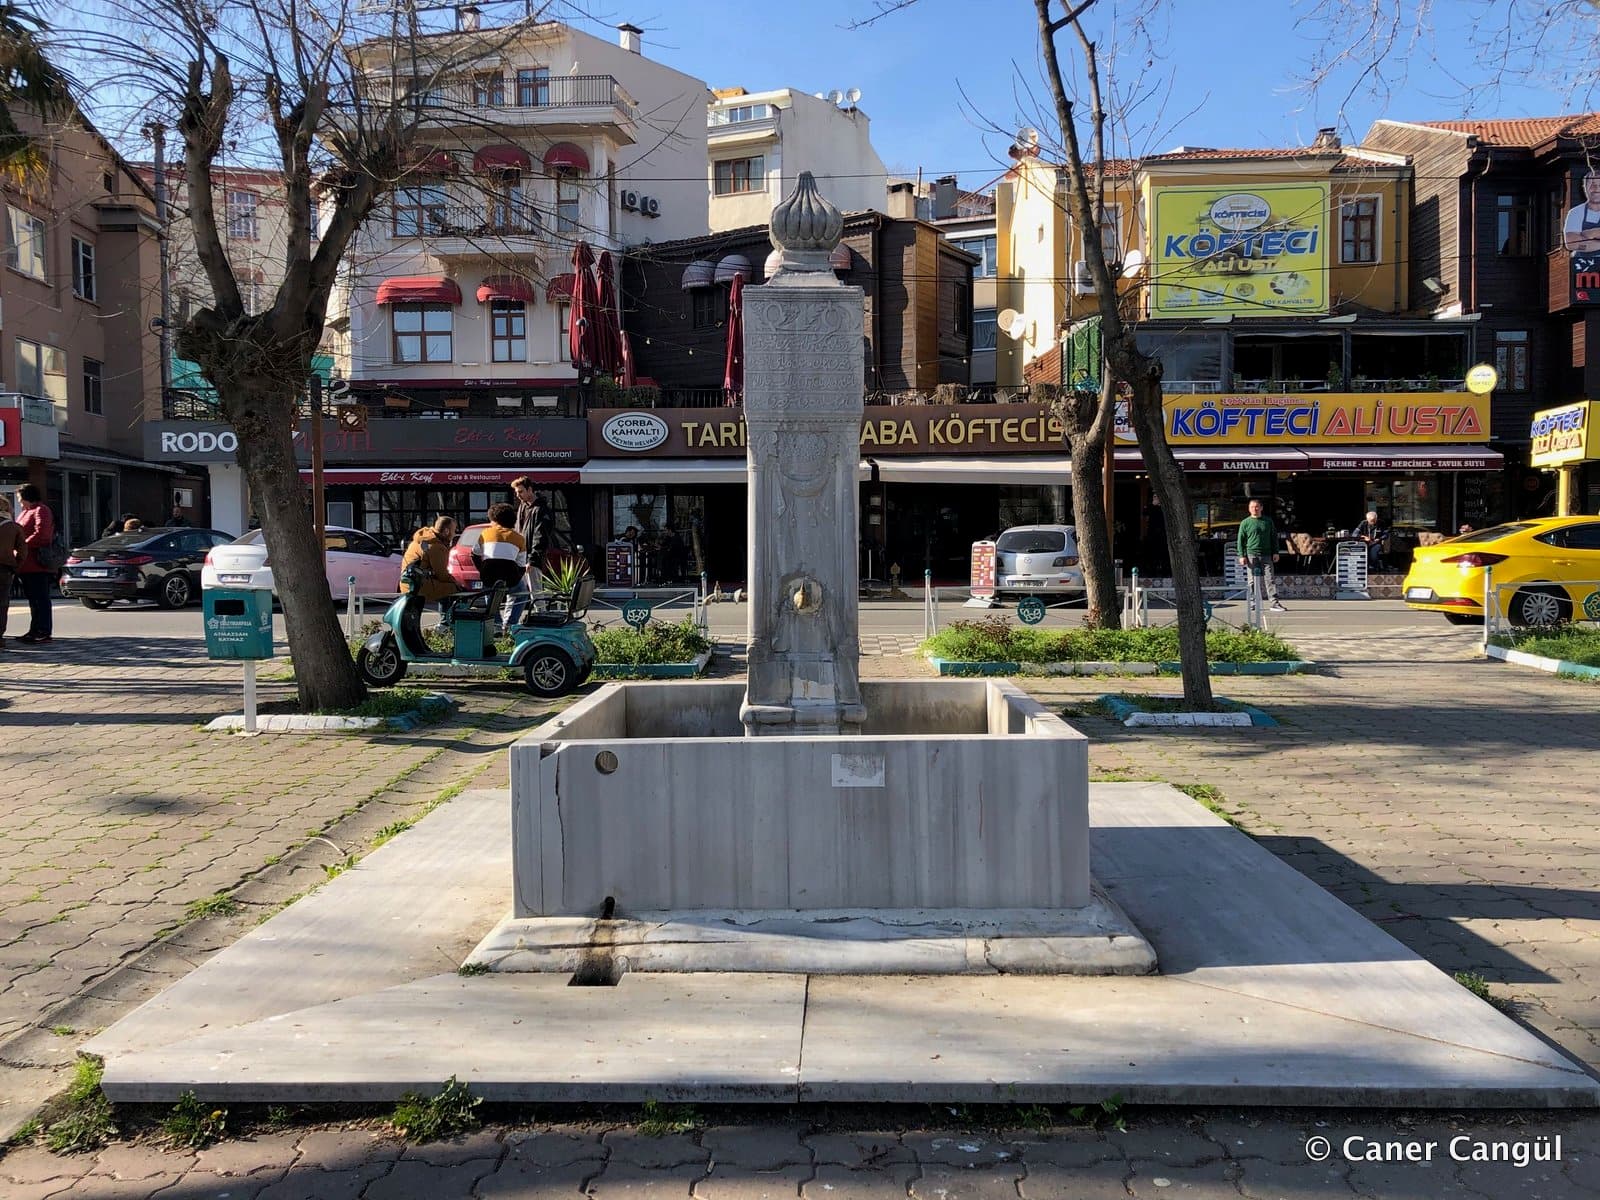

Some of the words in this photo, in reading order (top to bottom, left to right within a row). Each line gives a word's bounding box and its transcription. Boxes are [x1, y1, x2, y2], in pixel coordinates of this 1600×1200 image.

[1164, 224, 1319, 258] KÖFTECİ
[1202, 256, 1235, 273] ALİ
[617, 420, 653, 428] ÇORBA
[1172, 400, 1321, 436] KÖFTECİ
[1324, 400, 1384, 436] ALİ
[1390, 406, 1483, 435] USTA
[611, 428, 660, 436] KAHVALTI
[681, 415, 746, 447] TARİ
[860, 420, 918, 445] ABA
[928, 410, 1065, 444] KÖFTECİS
[503, 426, 543, 446] Keyf
[162, 432, 238, 453] RODO
[502, 450, 523, 458] Cafe
[524, 450, 530, 458] &
[532, 450, 572, 458] Restaurant
[1199, 462, 1207, 470] &
[1223, 462, 1269, 470] KAHVALTI
[1323, 460, 1358, 468] İŞKEMBE
[1391, 459, 1432, 468] MERCİMEK
[380, 472, 405, 482] Ehl-i
[410, 472, 435, 484] Keyf
[469, 473, 501, 481] Restaurant
